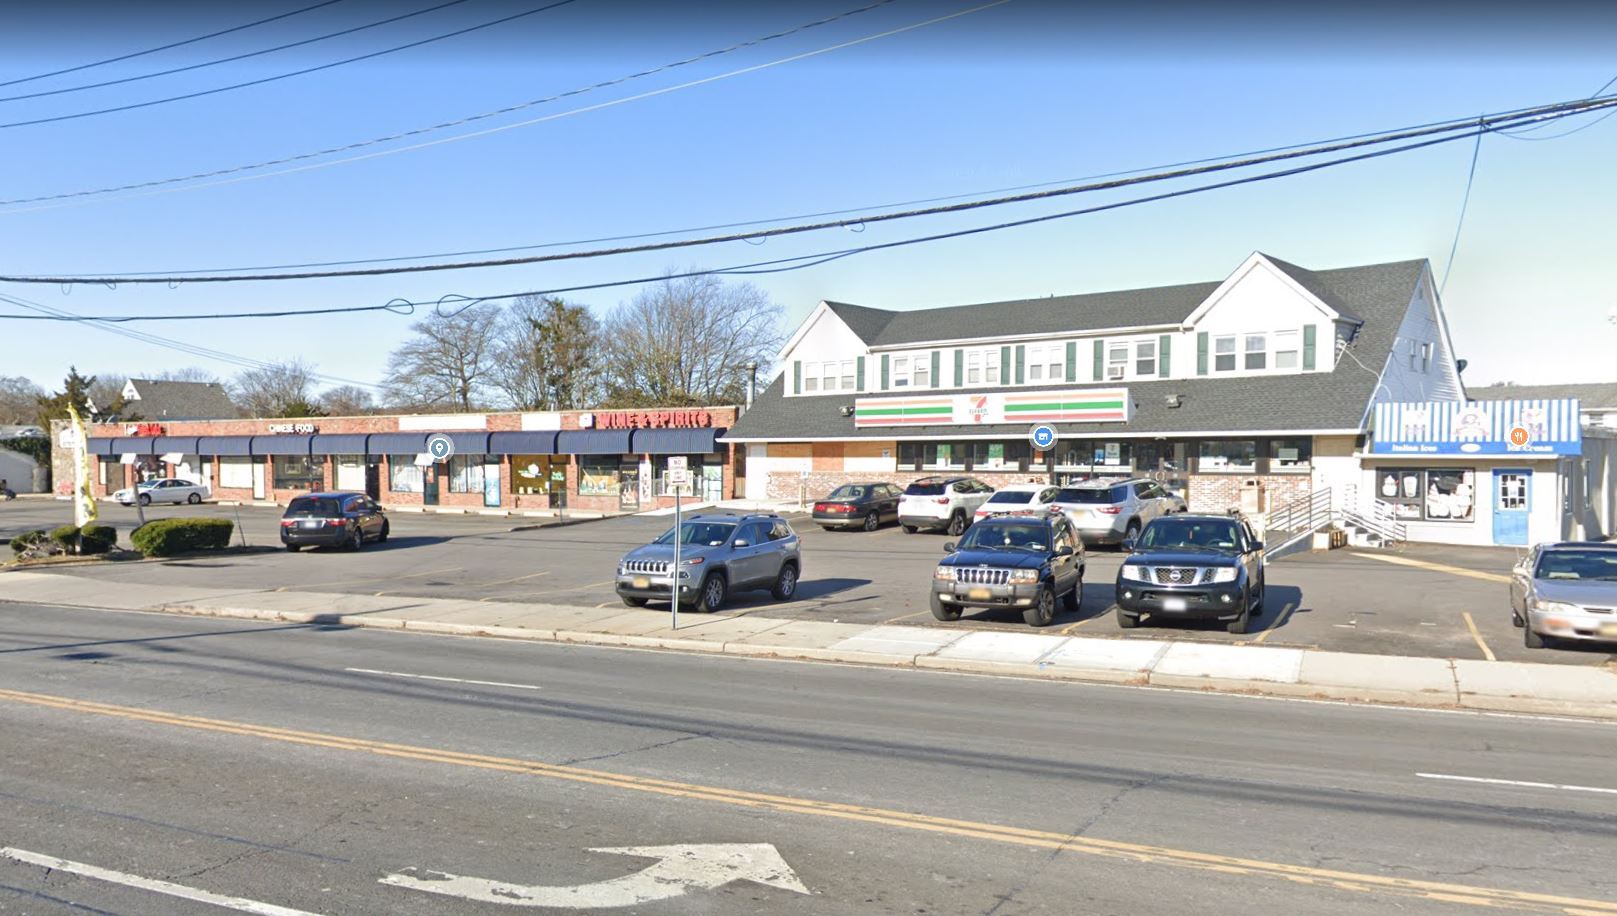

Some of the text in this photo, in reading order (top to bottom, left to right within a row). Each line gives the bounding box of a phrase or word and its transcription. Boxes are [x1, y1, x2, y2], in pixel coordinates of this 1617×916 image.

[970, 396, 987, 422] 7
[598, 412, 637, 428] WINE
[651, 411, 710, 427] SPIRITS
[295, 423, 315, 433] FOOD
[1392, 444, 1418, 452] Italian
